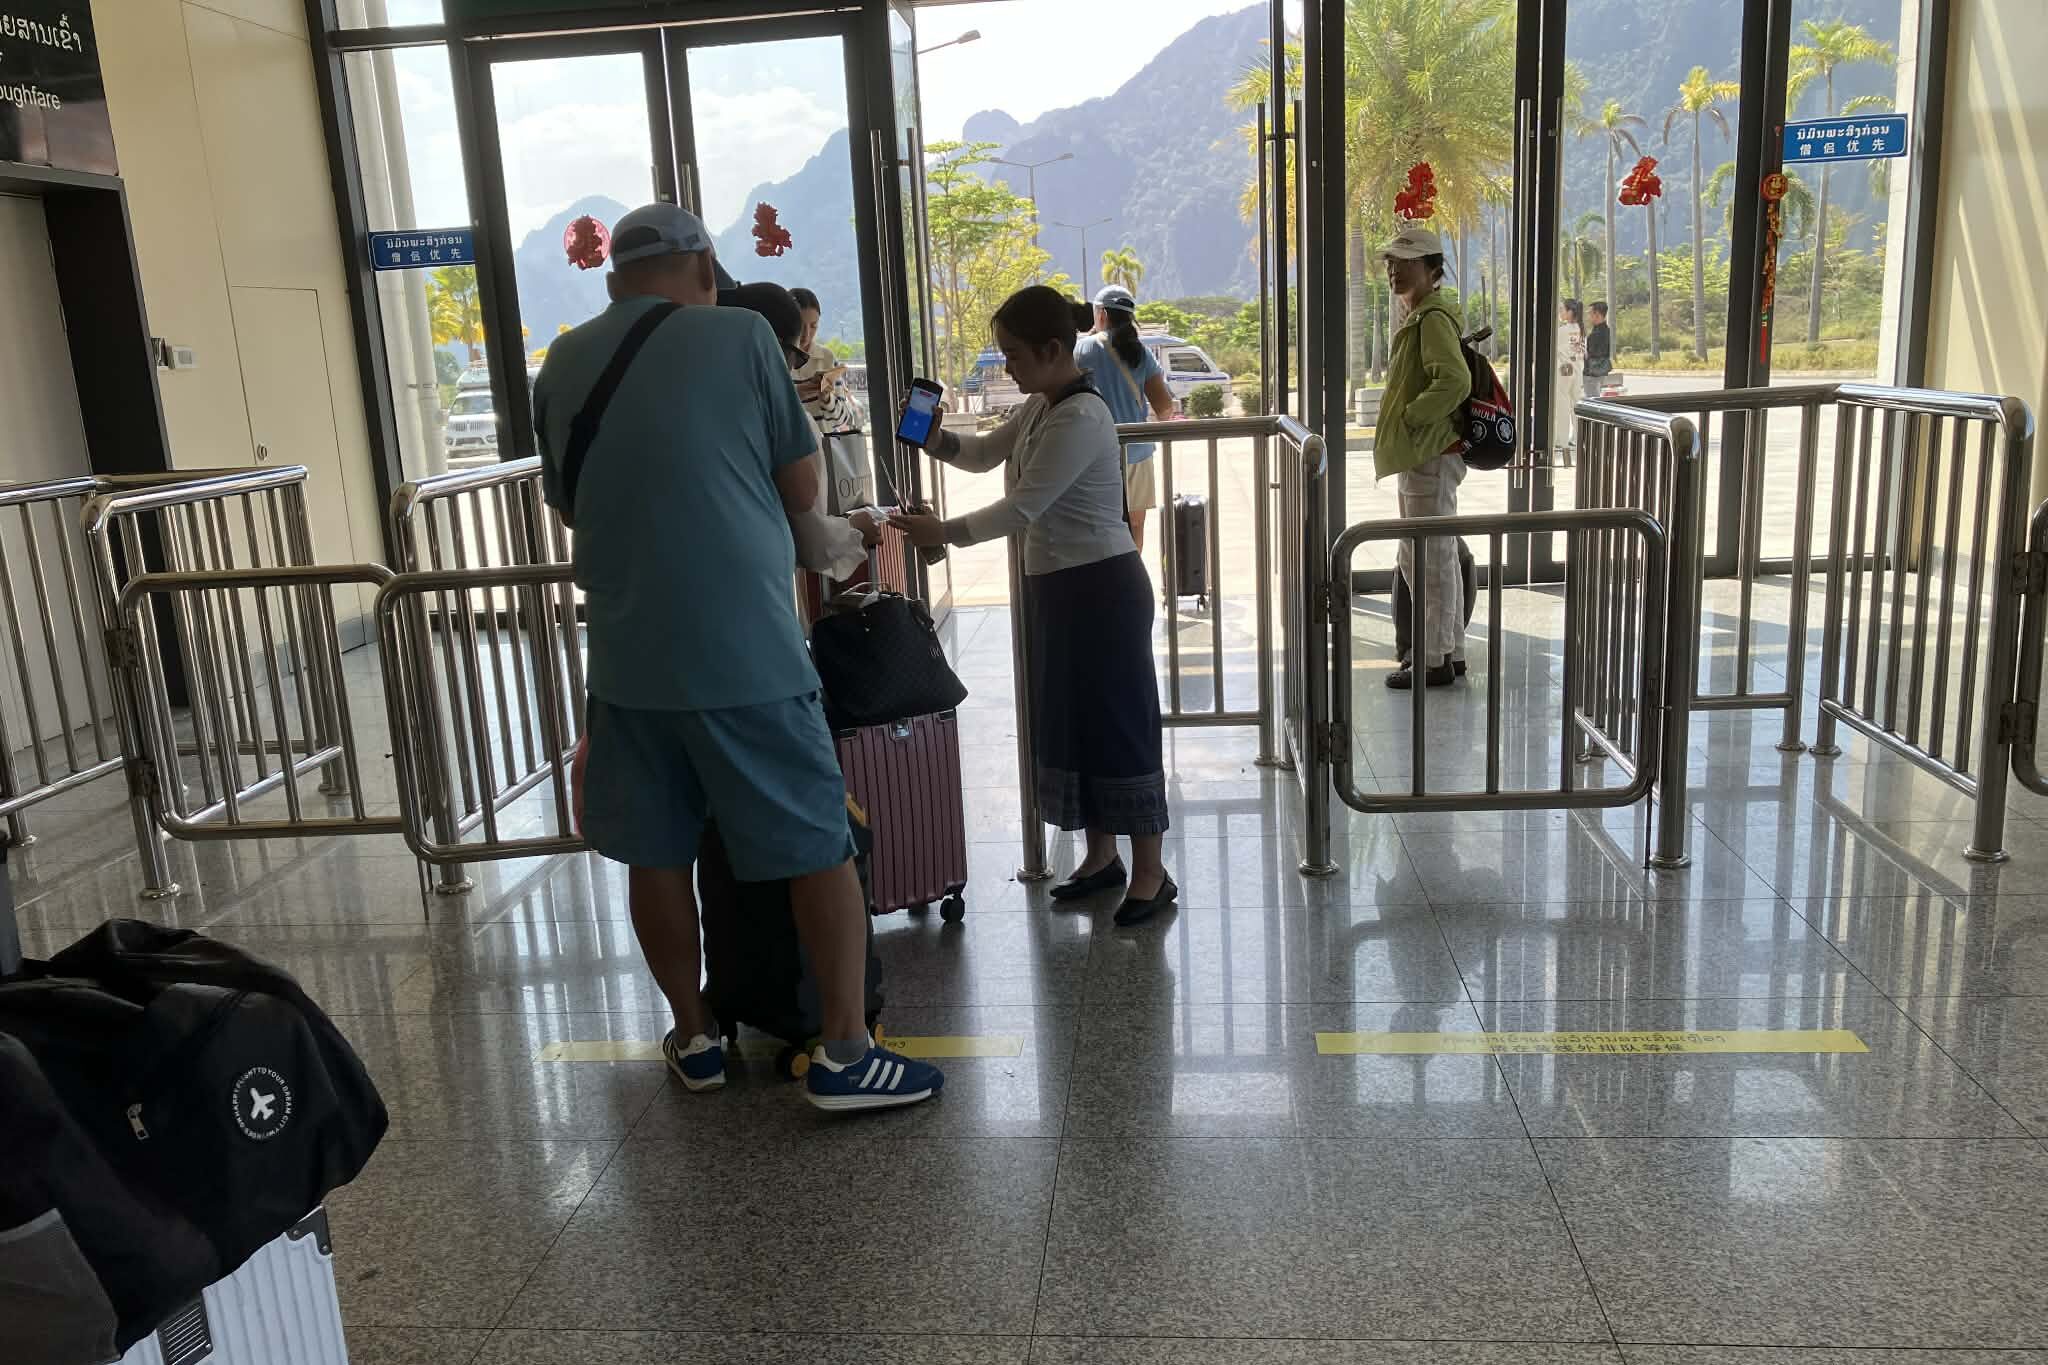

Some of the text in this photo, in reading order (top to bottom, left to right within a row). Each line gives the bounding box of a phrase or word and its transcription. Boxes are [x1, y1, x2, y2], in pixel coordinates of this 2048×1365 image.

[0, 13, 82, 53] ຍສານເຂົ້າ
[1799, 138, 1886, 156] 僧侣优先
